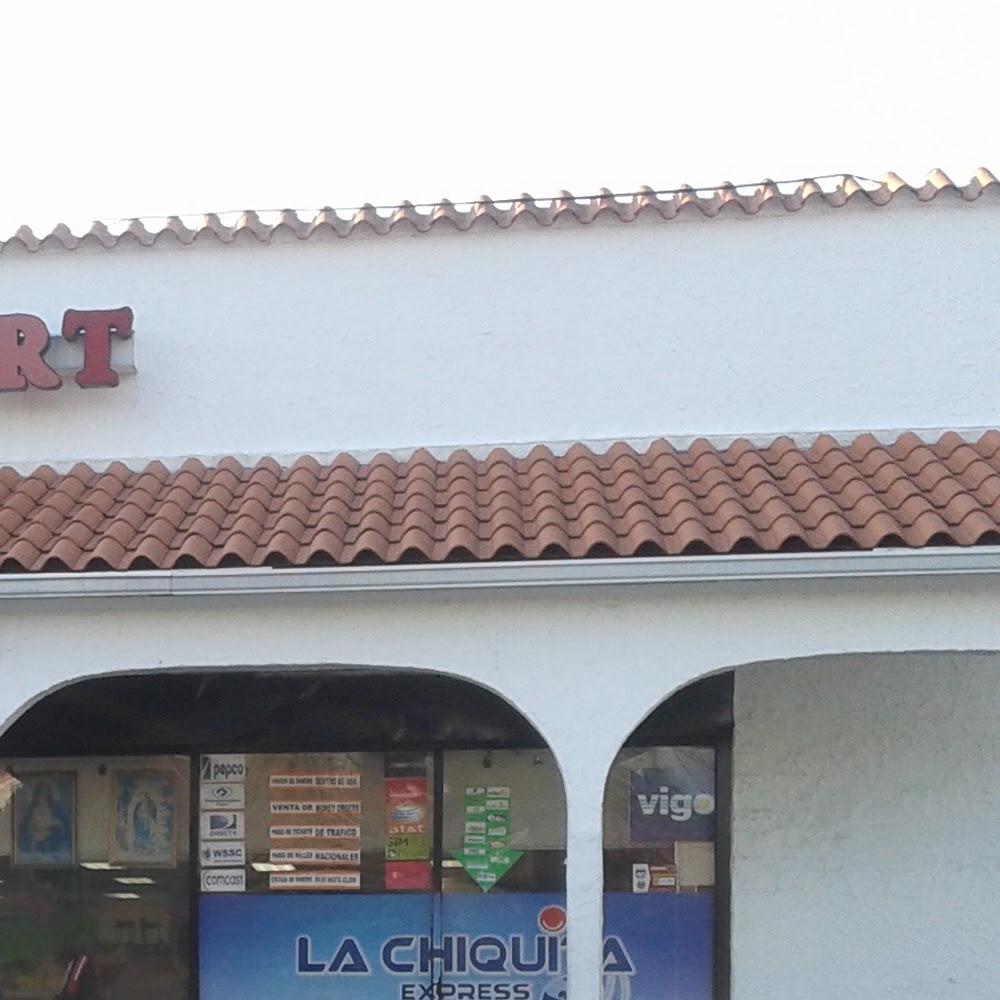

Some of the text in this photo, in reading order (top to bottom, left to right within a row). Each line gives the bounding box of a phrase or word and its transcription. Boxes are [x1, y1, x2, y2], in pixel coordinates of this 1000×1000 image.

[213, 763, 244, 780] pepco
[272, 804, 300, 812] VENTA
[637, 786, 715, 821] vigo
[213, 849, 243, 858] WSSC
[205, 873, 244, 886] comcast
[297, 936, 370, 973] LA
[402, 983, 530, 1000] EXPRESS
